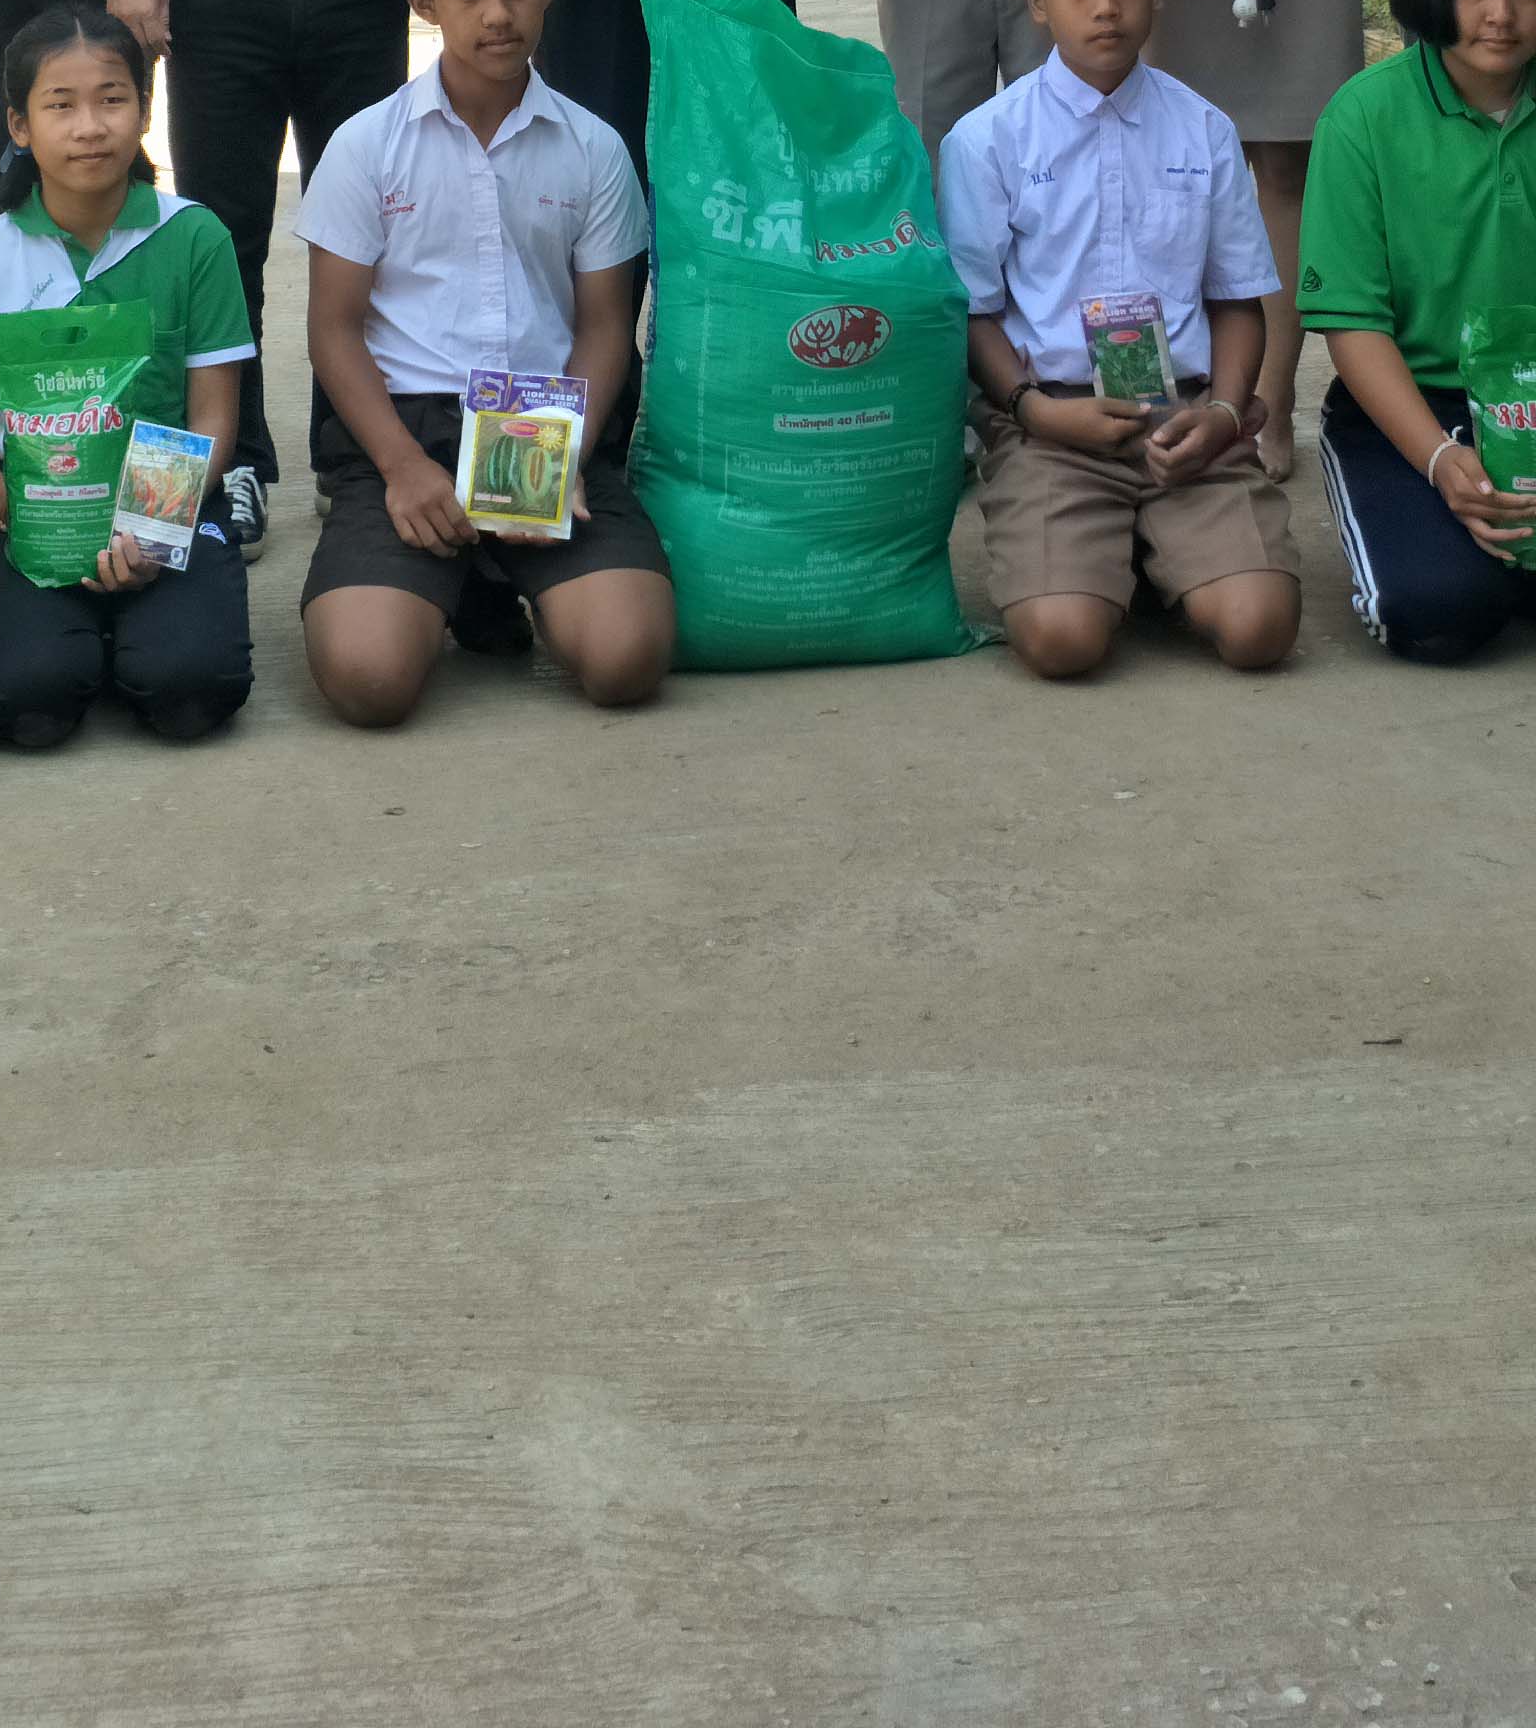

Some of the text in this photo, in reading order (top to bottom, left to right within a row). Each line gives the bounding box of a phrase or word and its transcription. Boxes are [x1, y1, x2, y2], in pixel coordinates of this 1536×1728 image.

[34, 368, 106, 399] ปุ๋ยอินทรีย์
[521, 389, 579, 403] LION SEEDS
[3, 395, 123, 437] หมอดิน
